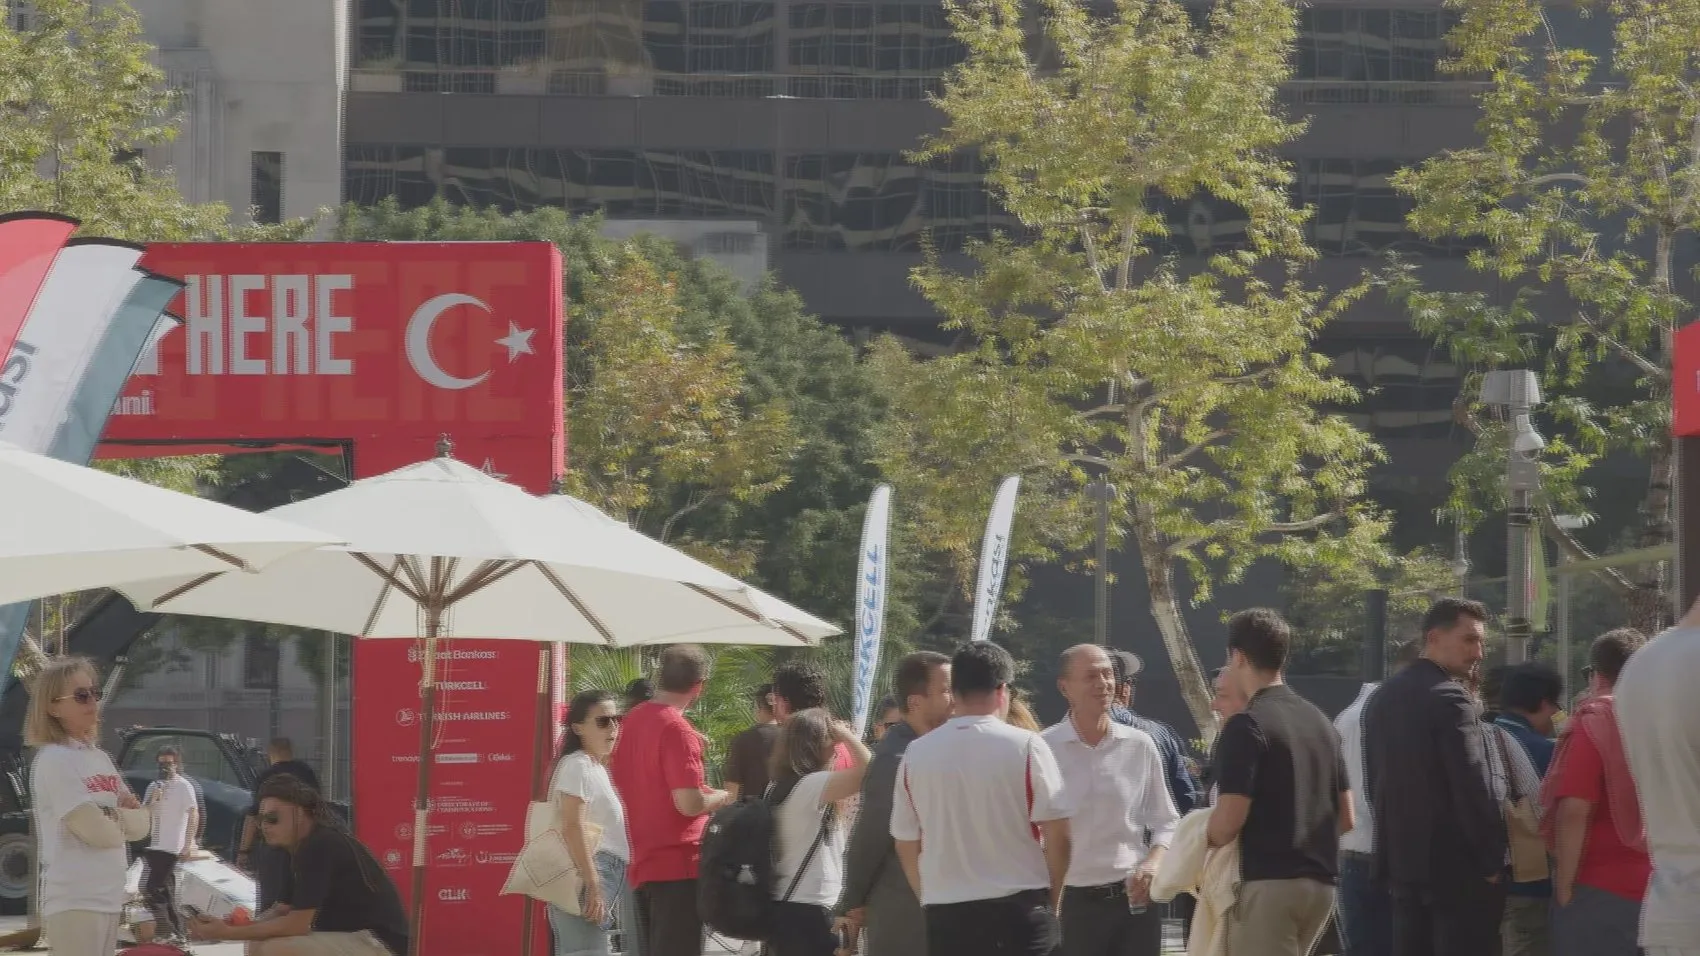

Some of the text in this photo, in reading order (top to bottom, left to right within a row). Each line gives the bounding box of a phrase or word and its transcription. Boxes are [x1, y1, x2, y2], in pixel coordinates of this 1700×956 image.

[186, 274, 355, 375] HERE
[855, 544, 878, 715] URKCELL
[418, 711, 508, 721] TRKISH AIRLINES
